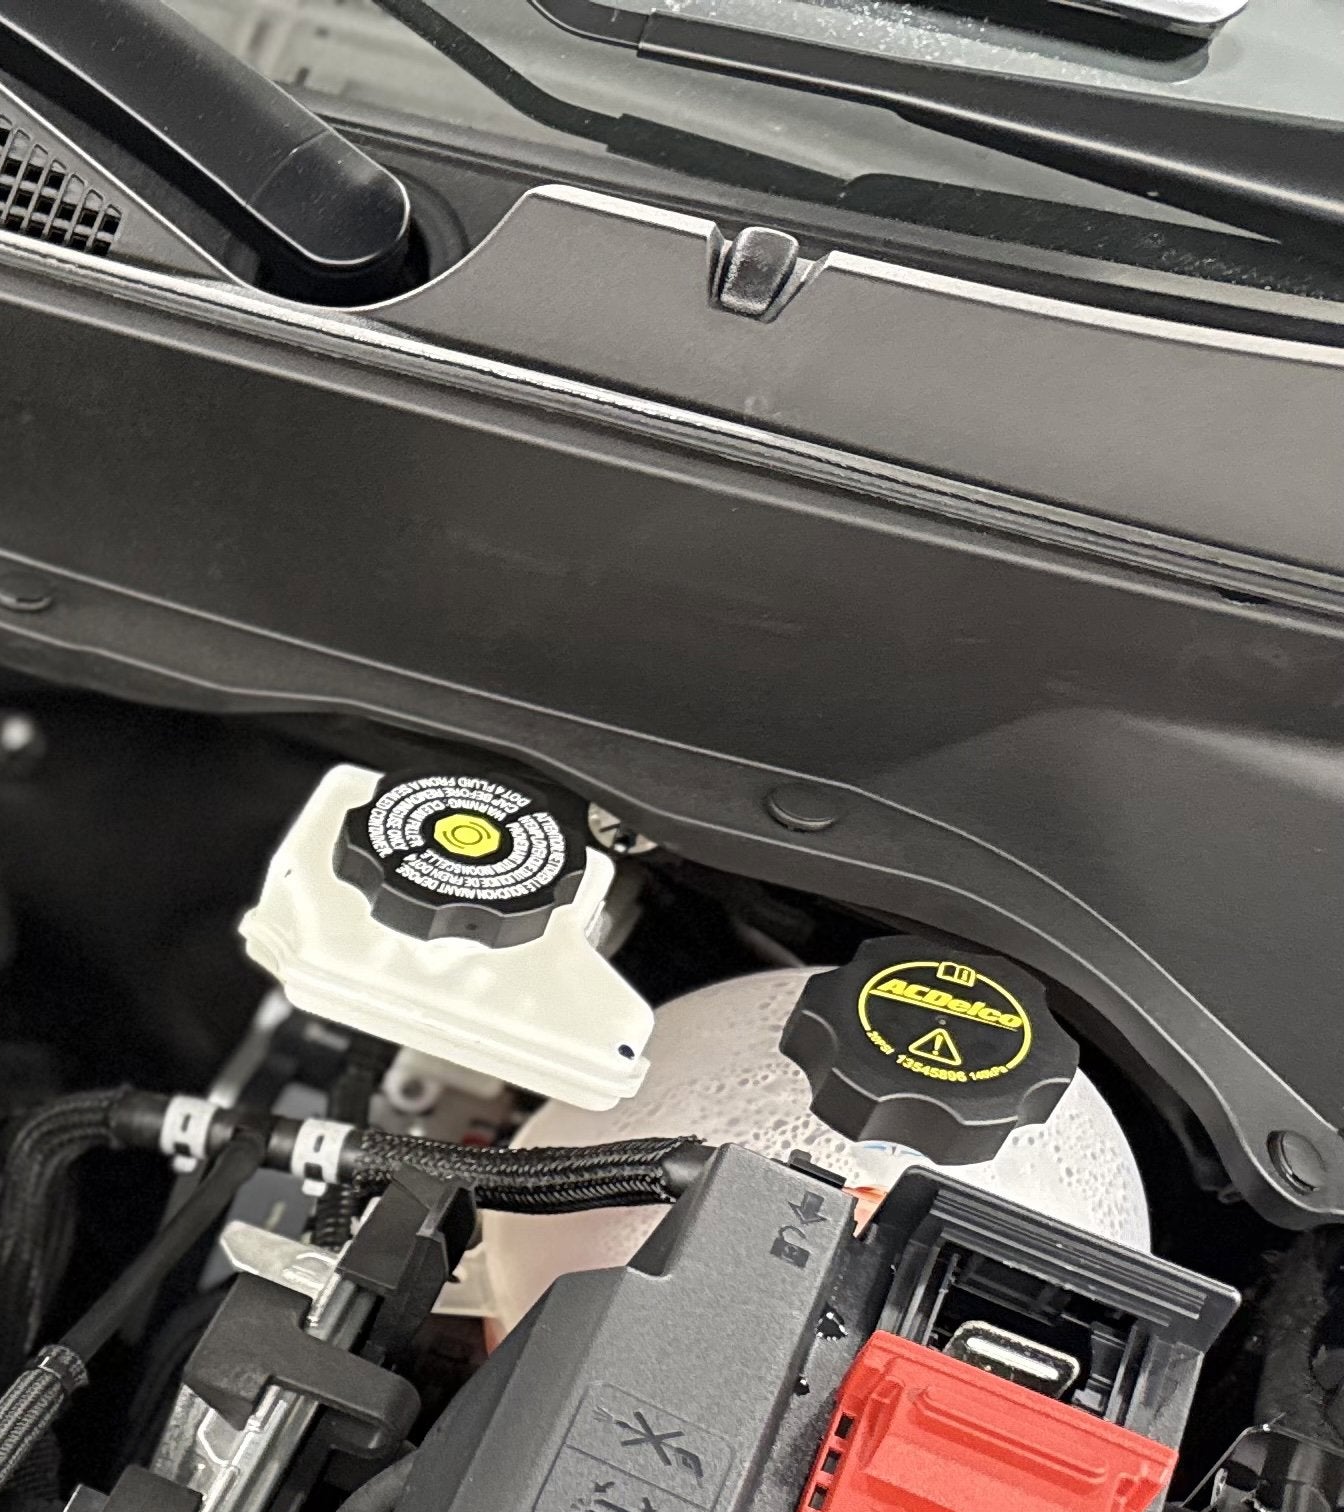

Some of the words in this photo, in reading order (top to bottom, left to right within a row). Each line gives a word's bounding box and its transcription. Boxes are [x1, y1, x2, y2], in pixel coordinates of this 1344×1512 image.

[417, 776, 457, 789] FROM
[457, 776, 497, 793] FLUID
[441, 787, 494, 804] BEFORE
[490, 797, 520, 814] CAP
[877, 978, 1023, 1028] ACDelco
